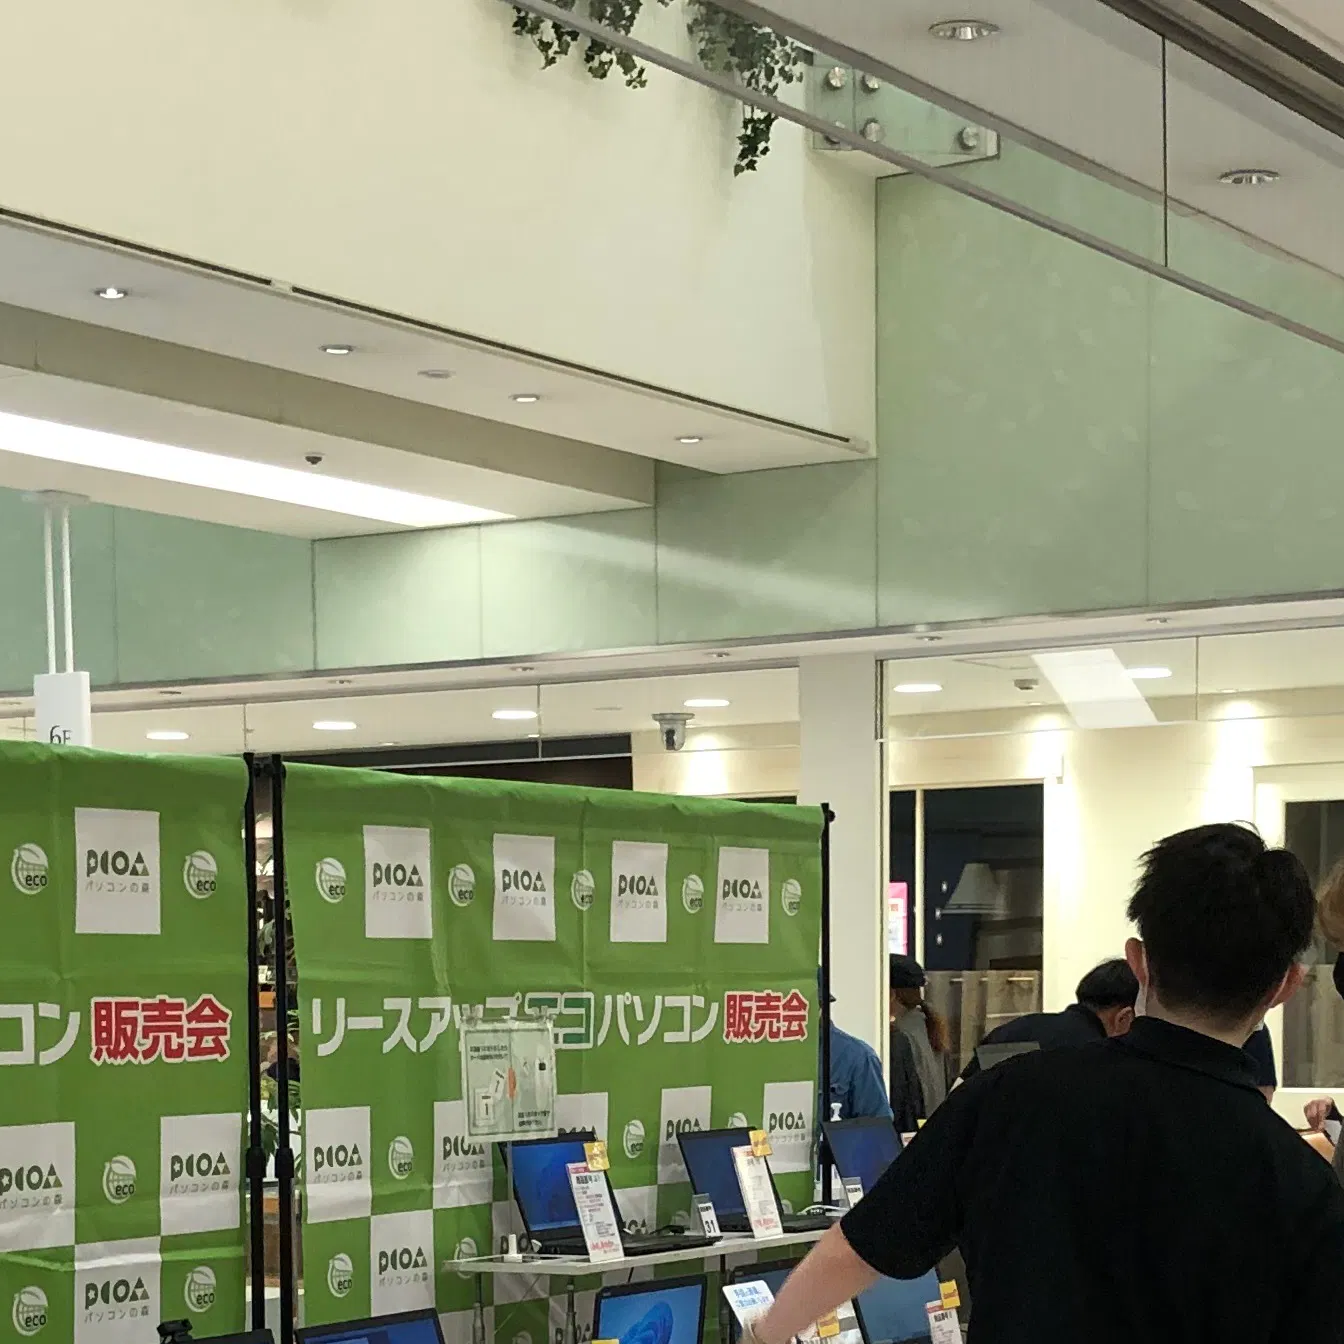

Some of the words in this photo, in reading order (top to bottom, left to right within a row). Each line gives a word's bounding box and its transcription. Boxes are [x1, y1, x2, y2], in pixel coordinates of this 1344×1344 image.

[25, 874, 48, 888] eco
[85, 880, 150, 894] パソコンの森
[197, 880, 216, 892] eco
[328, 884, 346, 896] eco
[458, 888, 475, 901] eco
[581, 893, 594, 906] eco
[689, 894, 703, 907] eco
[398, 1160, 413, 1172] eco
[115, 1182, 135, 1196] eco
[169, 1179, 230, 1195] パソコンの森
[704, 1220, 714, 1233] 31
[337, 1279, 353, 1291] eco
[196, 1291, 216, 1305] eco
[25, 1314, 47, 1328] eco
[84, 1305, 150, 1324] パソコンの森
